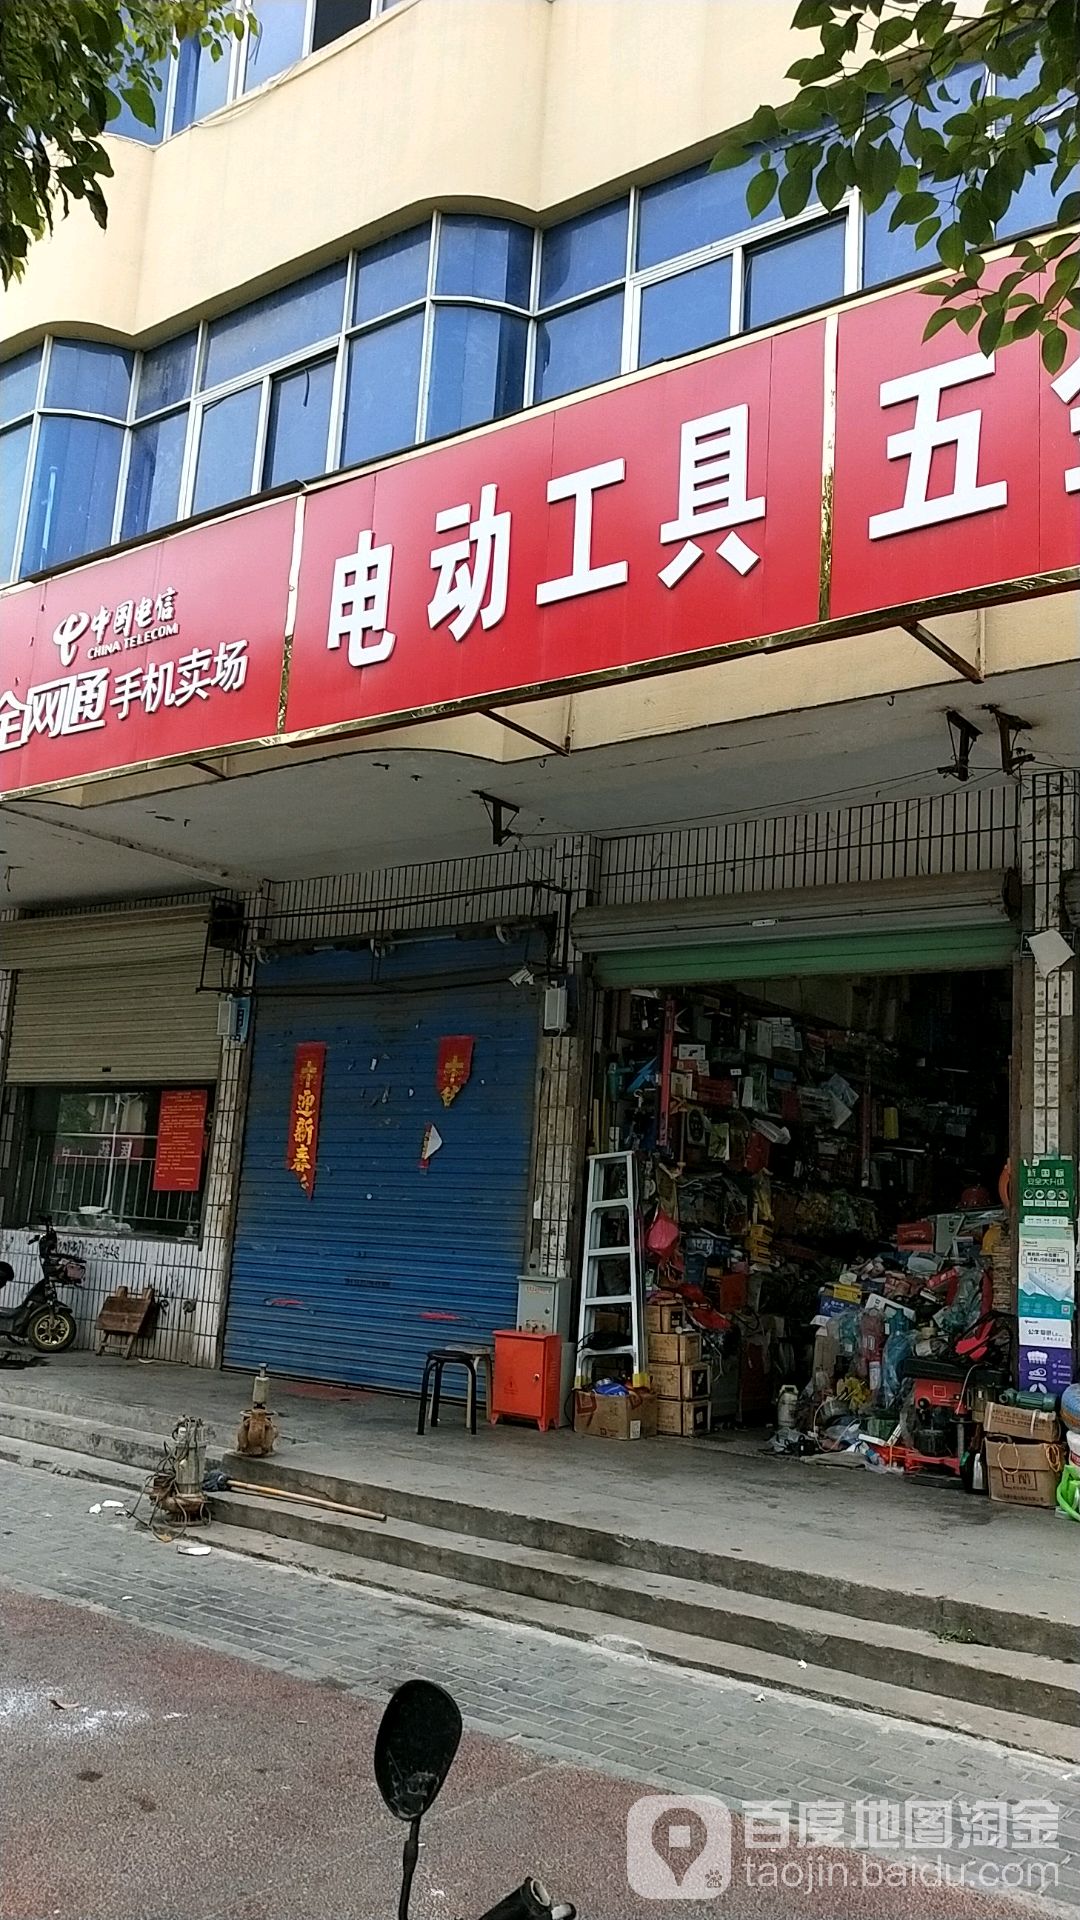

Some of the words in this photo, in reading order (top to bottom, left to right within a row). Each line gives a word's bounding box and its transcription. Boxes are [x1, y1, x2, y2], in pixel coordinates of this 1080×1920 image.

[327, 403, 767, 668] 电动工具
[87, 642, 122, 661] CHINA
[122, 621, 180, 652] TELECOM
[90, 586, 178, 645] 中国电信
